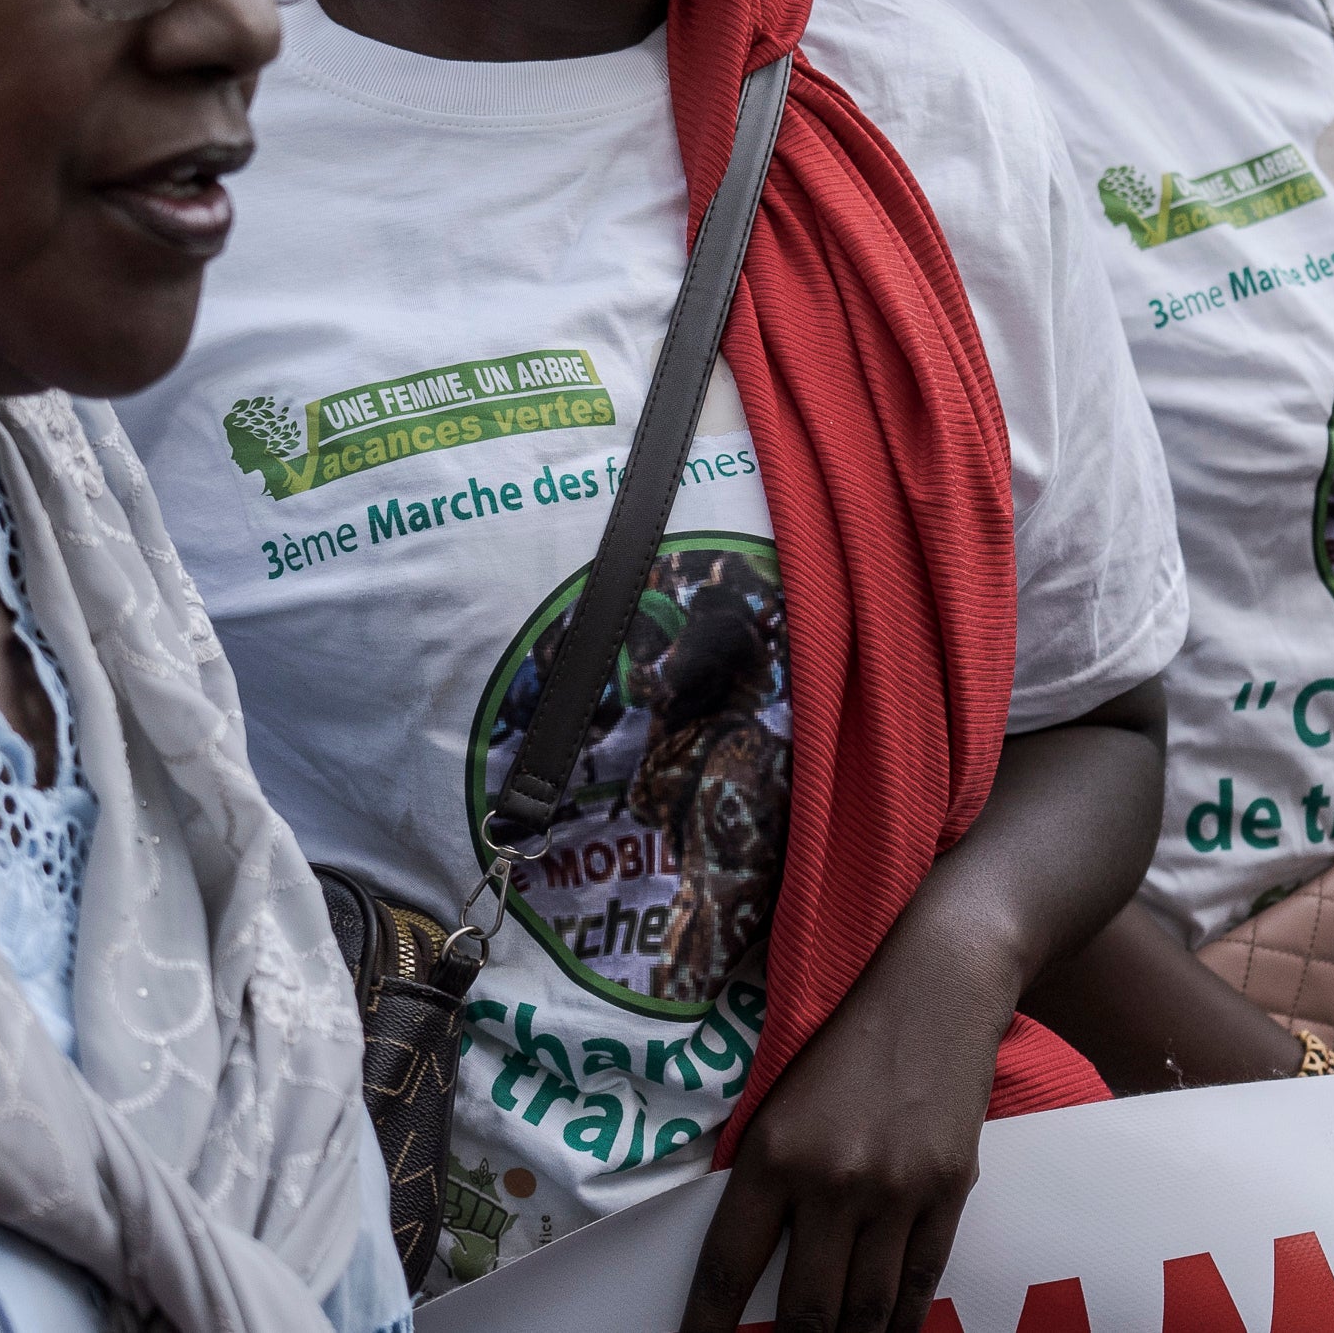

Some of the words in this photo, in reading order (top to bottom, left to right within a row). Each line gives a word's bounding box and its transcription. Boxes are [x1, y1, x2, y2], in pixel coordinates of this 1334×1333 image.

[1149, 285, 1225, 329] 3ème
[323, 392, 379, 430] UNE
[377, 372, 475, 415] FEMME,
[473, 366, 514, 395] UN
[516, 356, 591, 389] ARBRE
[492, 395, 612, 434] vertes
[261, 522, 358, 580] 3ème
[367, 478, 522, 545] Marche
[533, 466, 599, 505] des
[606, 451, 755, 495] fmes
[1186, 778, 1282, 853] de
